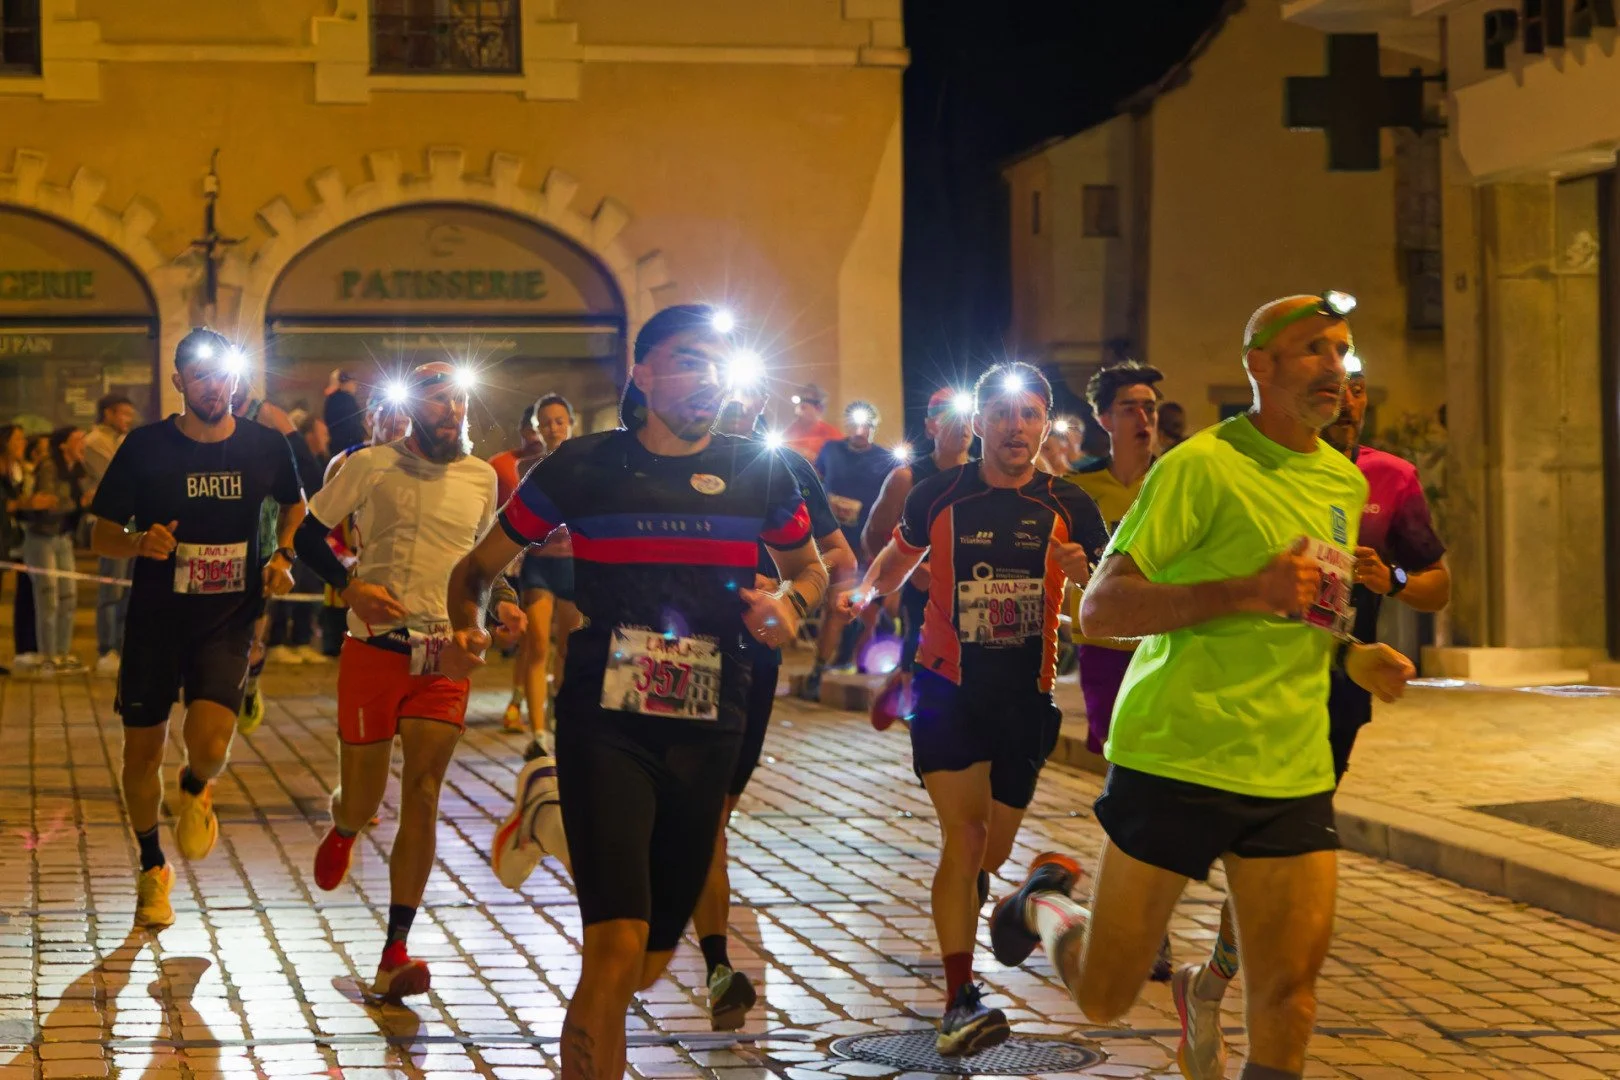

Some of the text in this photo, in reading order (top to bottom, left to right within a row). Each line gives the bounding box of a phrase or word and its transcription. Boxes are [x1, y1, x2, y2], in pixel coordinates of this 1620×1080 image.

[341, 268, 548, 300] PATISSERIE
[186, 476, 243, 499] BARTH
[188, 559, 233, 581] 1564
[989, 598, 1016, 625] 88
[635, 655, 692, 700] 357
